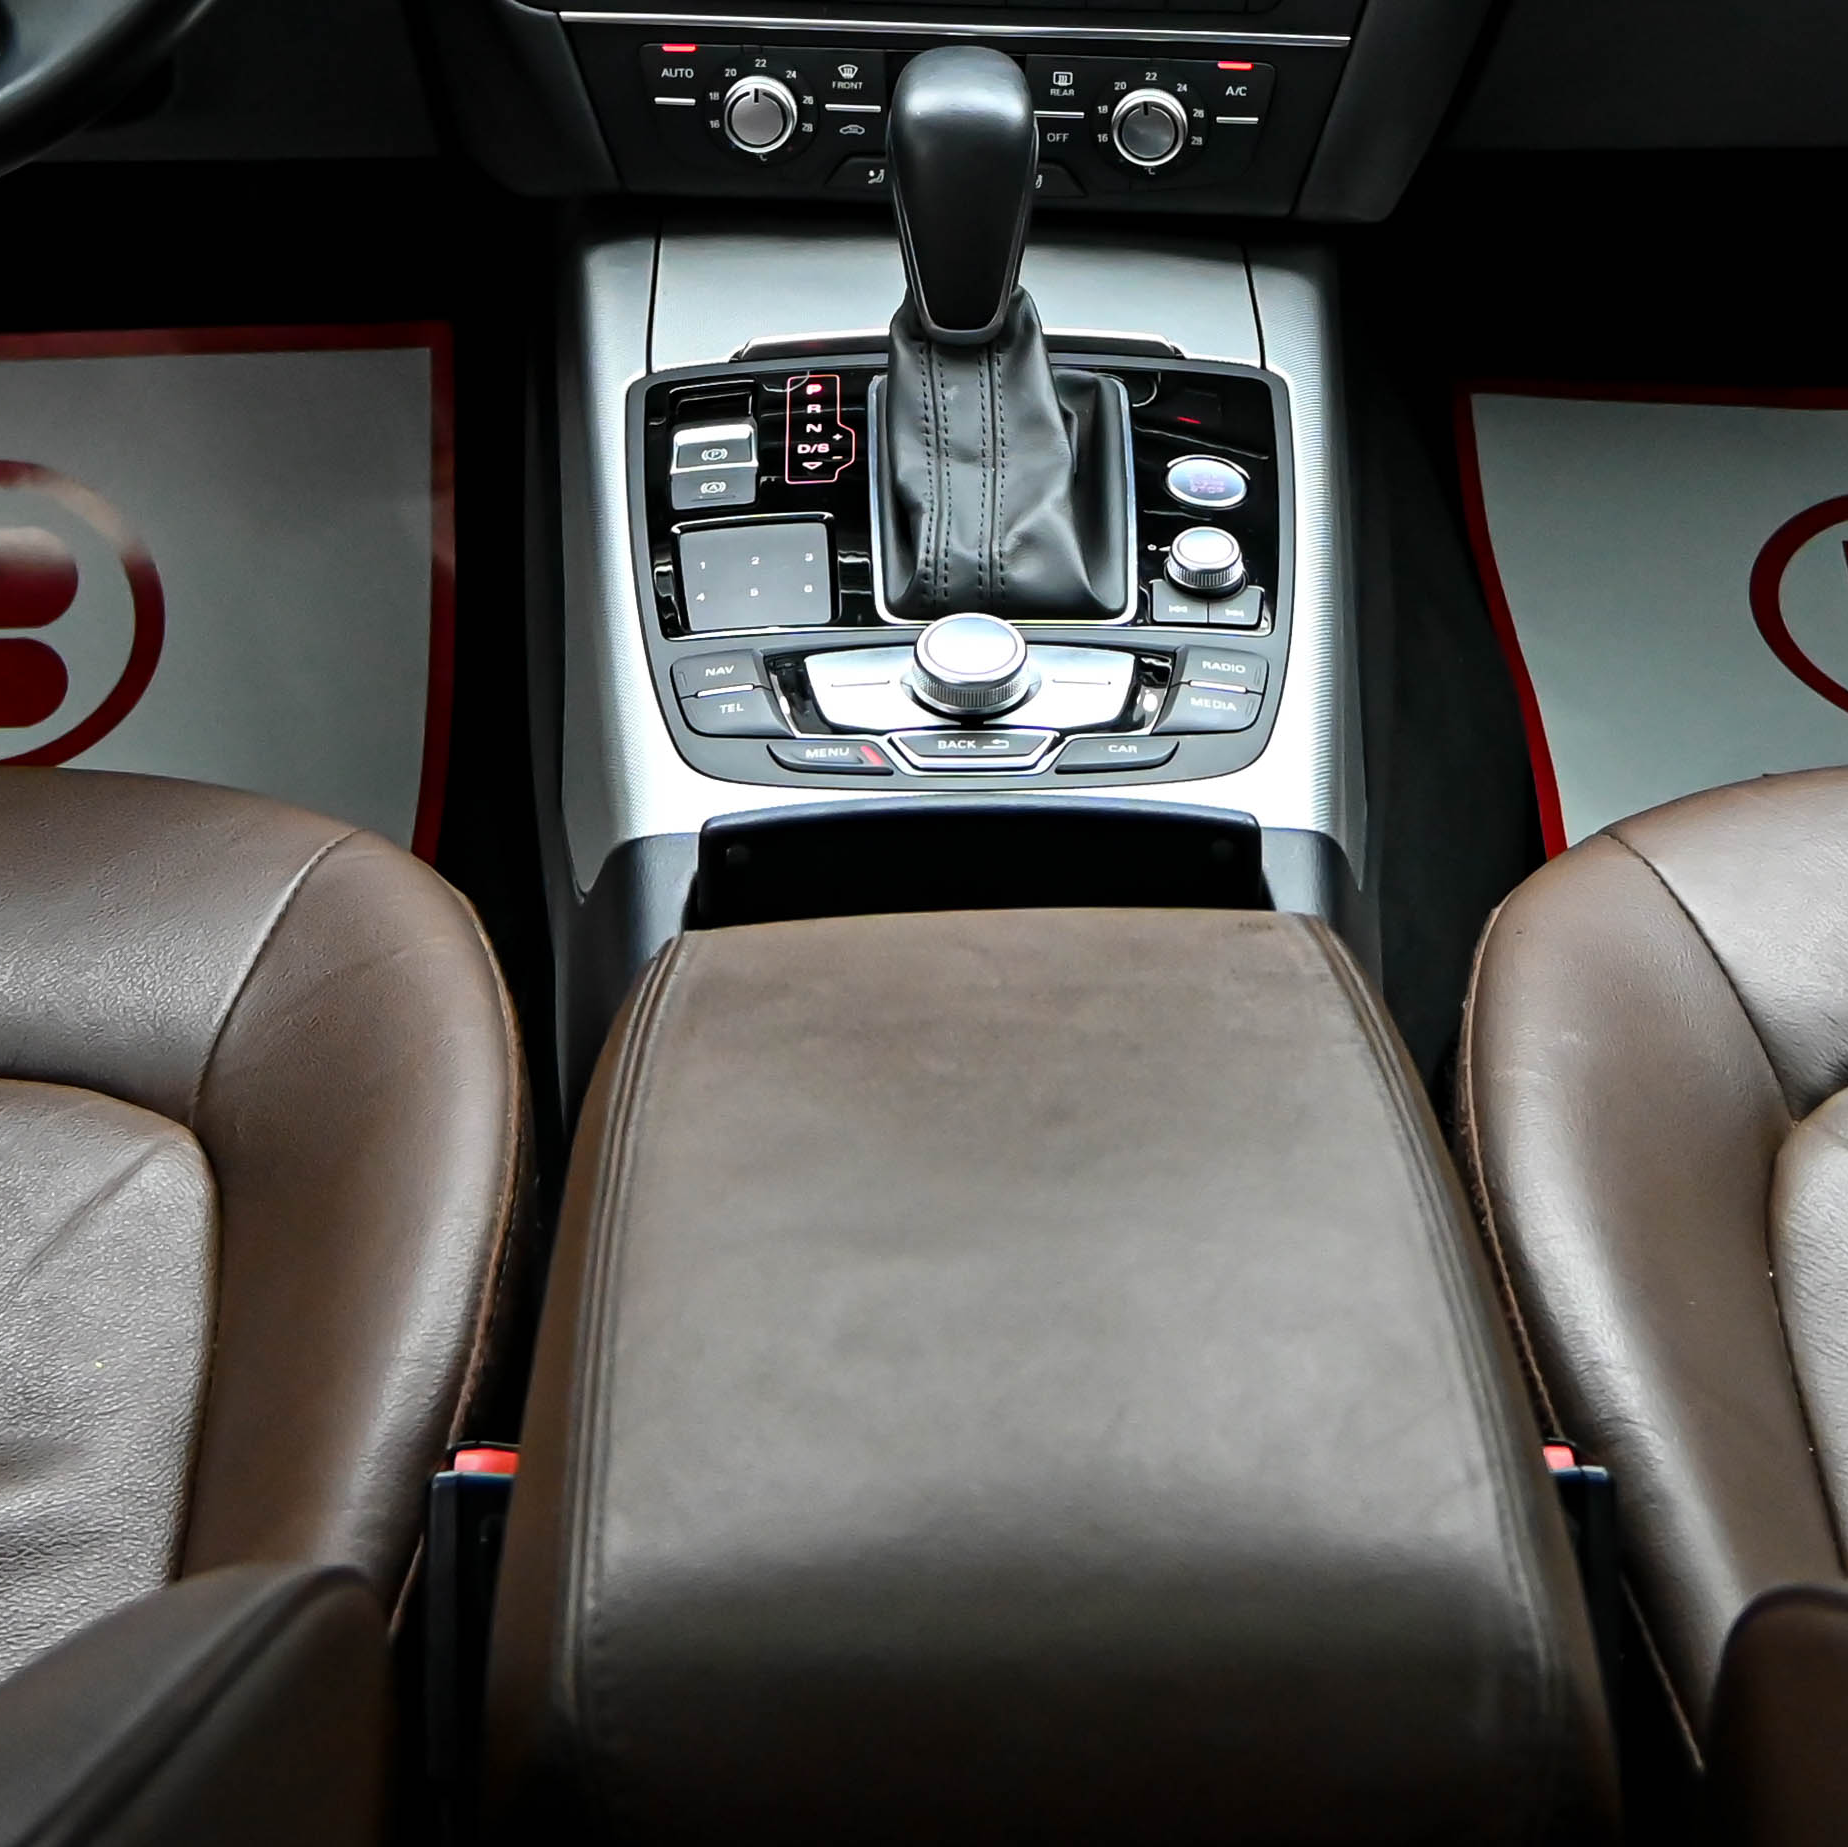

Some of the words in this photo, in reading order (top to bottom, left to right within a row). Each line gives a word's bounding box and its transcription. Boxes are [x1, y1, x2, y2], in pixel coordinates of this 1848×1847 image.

[754, 59, 767, 68] 22
[661, 68, 694, 78] AUTO
[724, 68, 737, 78] 20
[785, 70, 797, 80] 24
[1145, 72, 1158, 81] 22
[833, 81, 862, 89] FRONT
[1114, 82, 1127, 91] 20
[1176, 83, 1188, 93] 24
[1226, 86, 1247, 96] A/C
[1047, 133, 1069, 142] OFF
[806, 384, 822, 395] P
[807, 404, 822, 413] R
[806, 424, 822, 432] N
[798, 443, 829, 453] D/S
[752, 557, 759, 565] 2
[805, 553, 813, 561] 3
[696, 593, 705, 601] 4
[706, 666, 734, 676] NAV
[1203, 661, 1245, 673] RADIO
[720, 704, 744, 714] TEL
[1191, 697, 1237, 713] MEDIA
[938, 739, 976, 750] BACK
[1109, 744, 1138, 754] CAR
[806, 747, 850, 759] MENU
